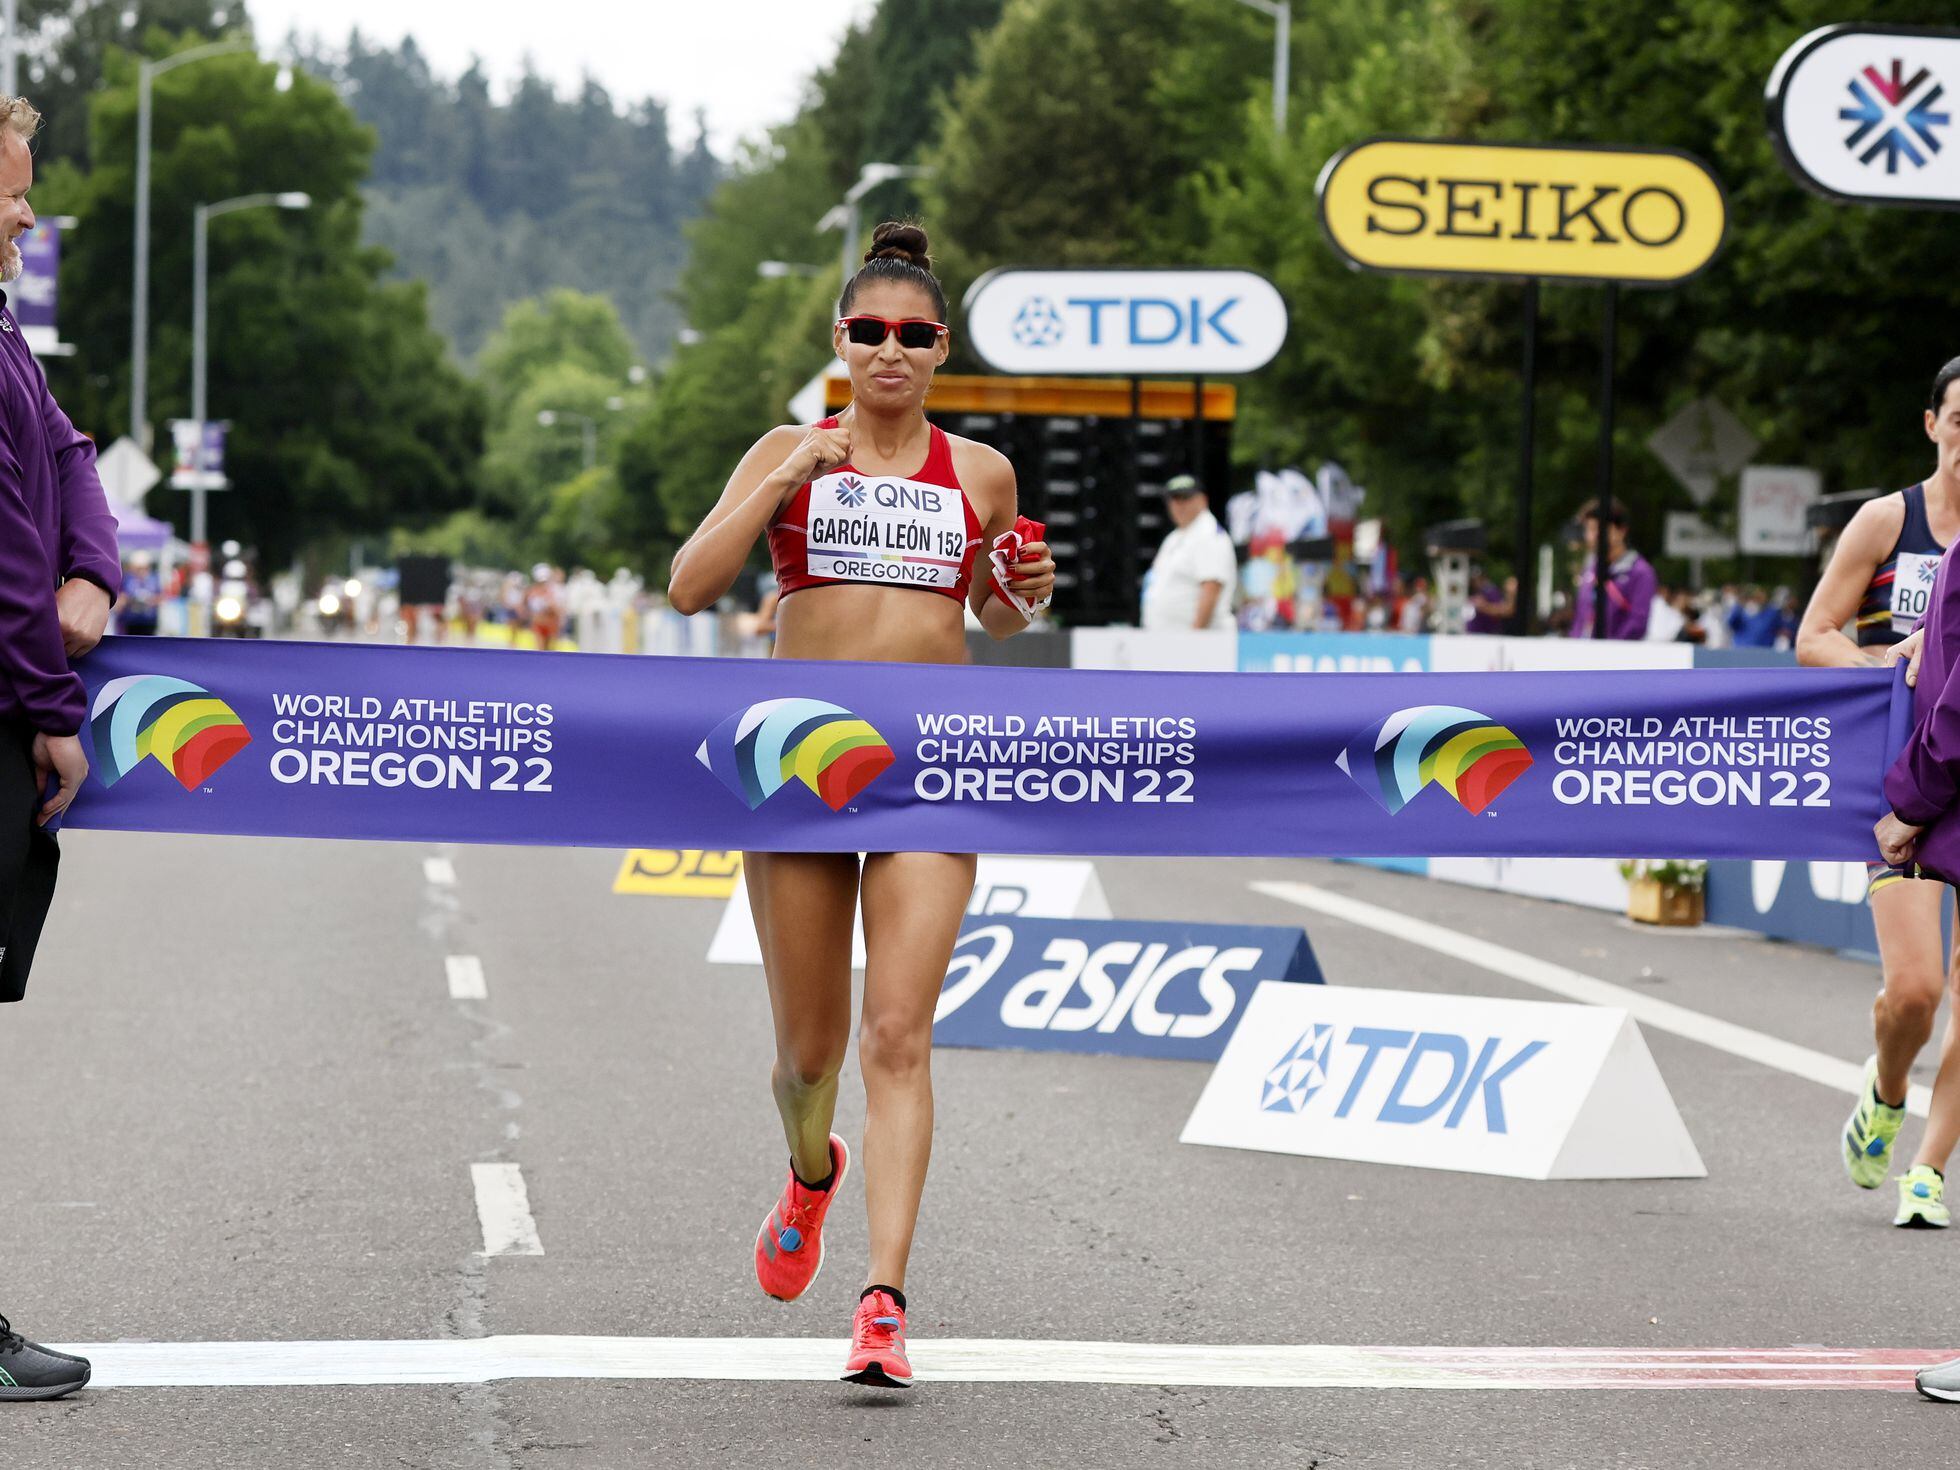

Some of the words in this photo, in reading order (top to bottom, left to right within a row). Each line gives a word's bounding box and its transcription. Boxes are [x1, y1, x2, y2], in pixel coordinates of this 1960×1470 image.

[1365, 175, 1688, 247] SEIKO
[1067, 297, 1243, 346] TDK
[874, 483, 942, 513] QNB
[813, 515, 880, 548] GARCÍA
[885, 519, 931, 552] LEÓN
[937, 530, 963, 558] 152
[833, 560, 940, 583] OREGON22
[272, 693, 382, 719] WORLD
[389, 698, 554, 726] ATHLETICS
[272, 719, 553, 753] CHAMPIONSHIPS
[915, 713, 1026, 737] WORLD
[1032, 715, 1197, 739] ATHLETICS
[1555, 717, 1663, 738] WORLD
[1669, 716, 1832, 740] ATHLETICS
[916, 738, 1195, 765] CHAMPIONSHIPS
[1554, 741, 1831, 768] CHAMPIONSHIPS
[1334, 1026, 1552, 1135] TDK
